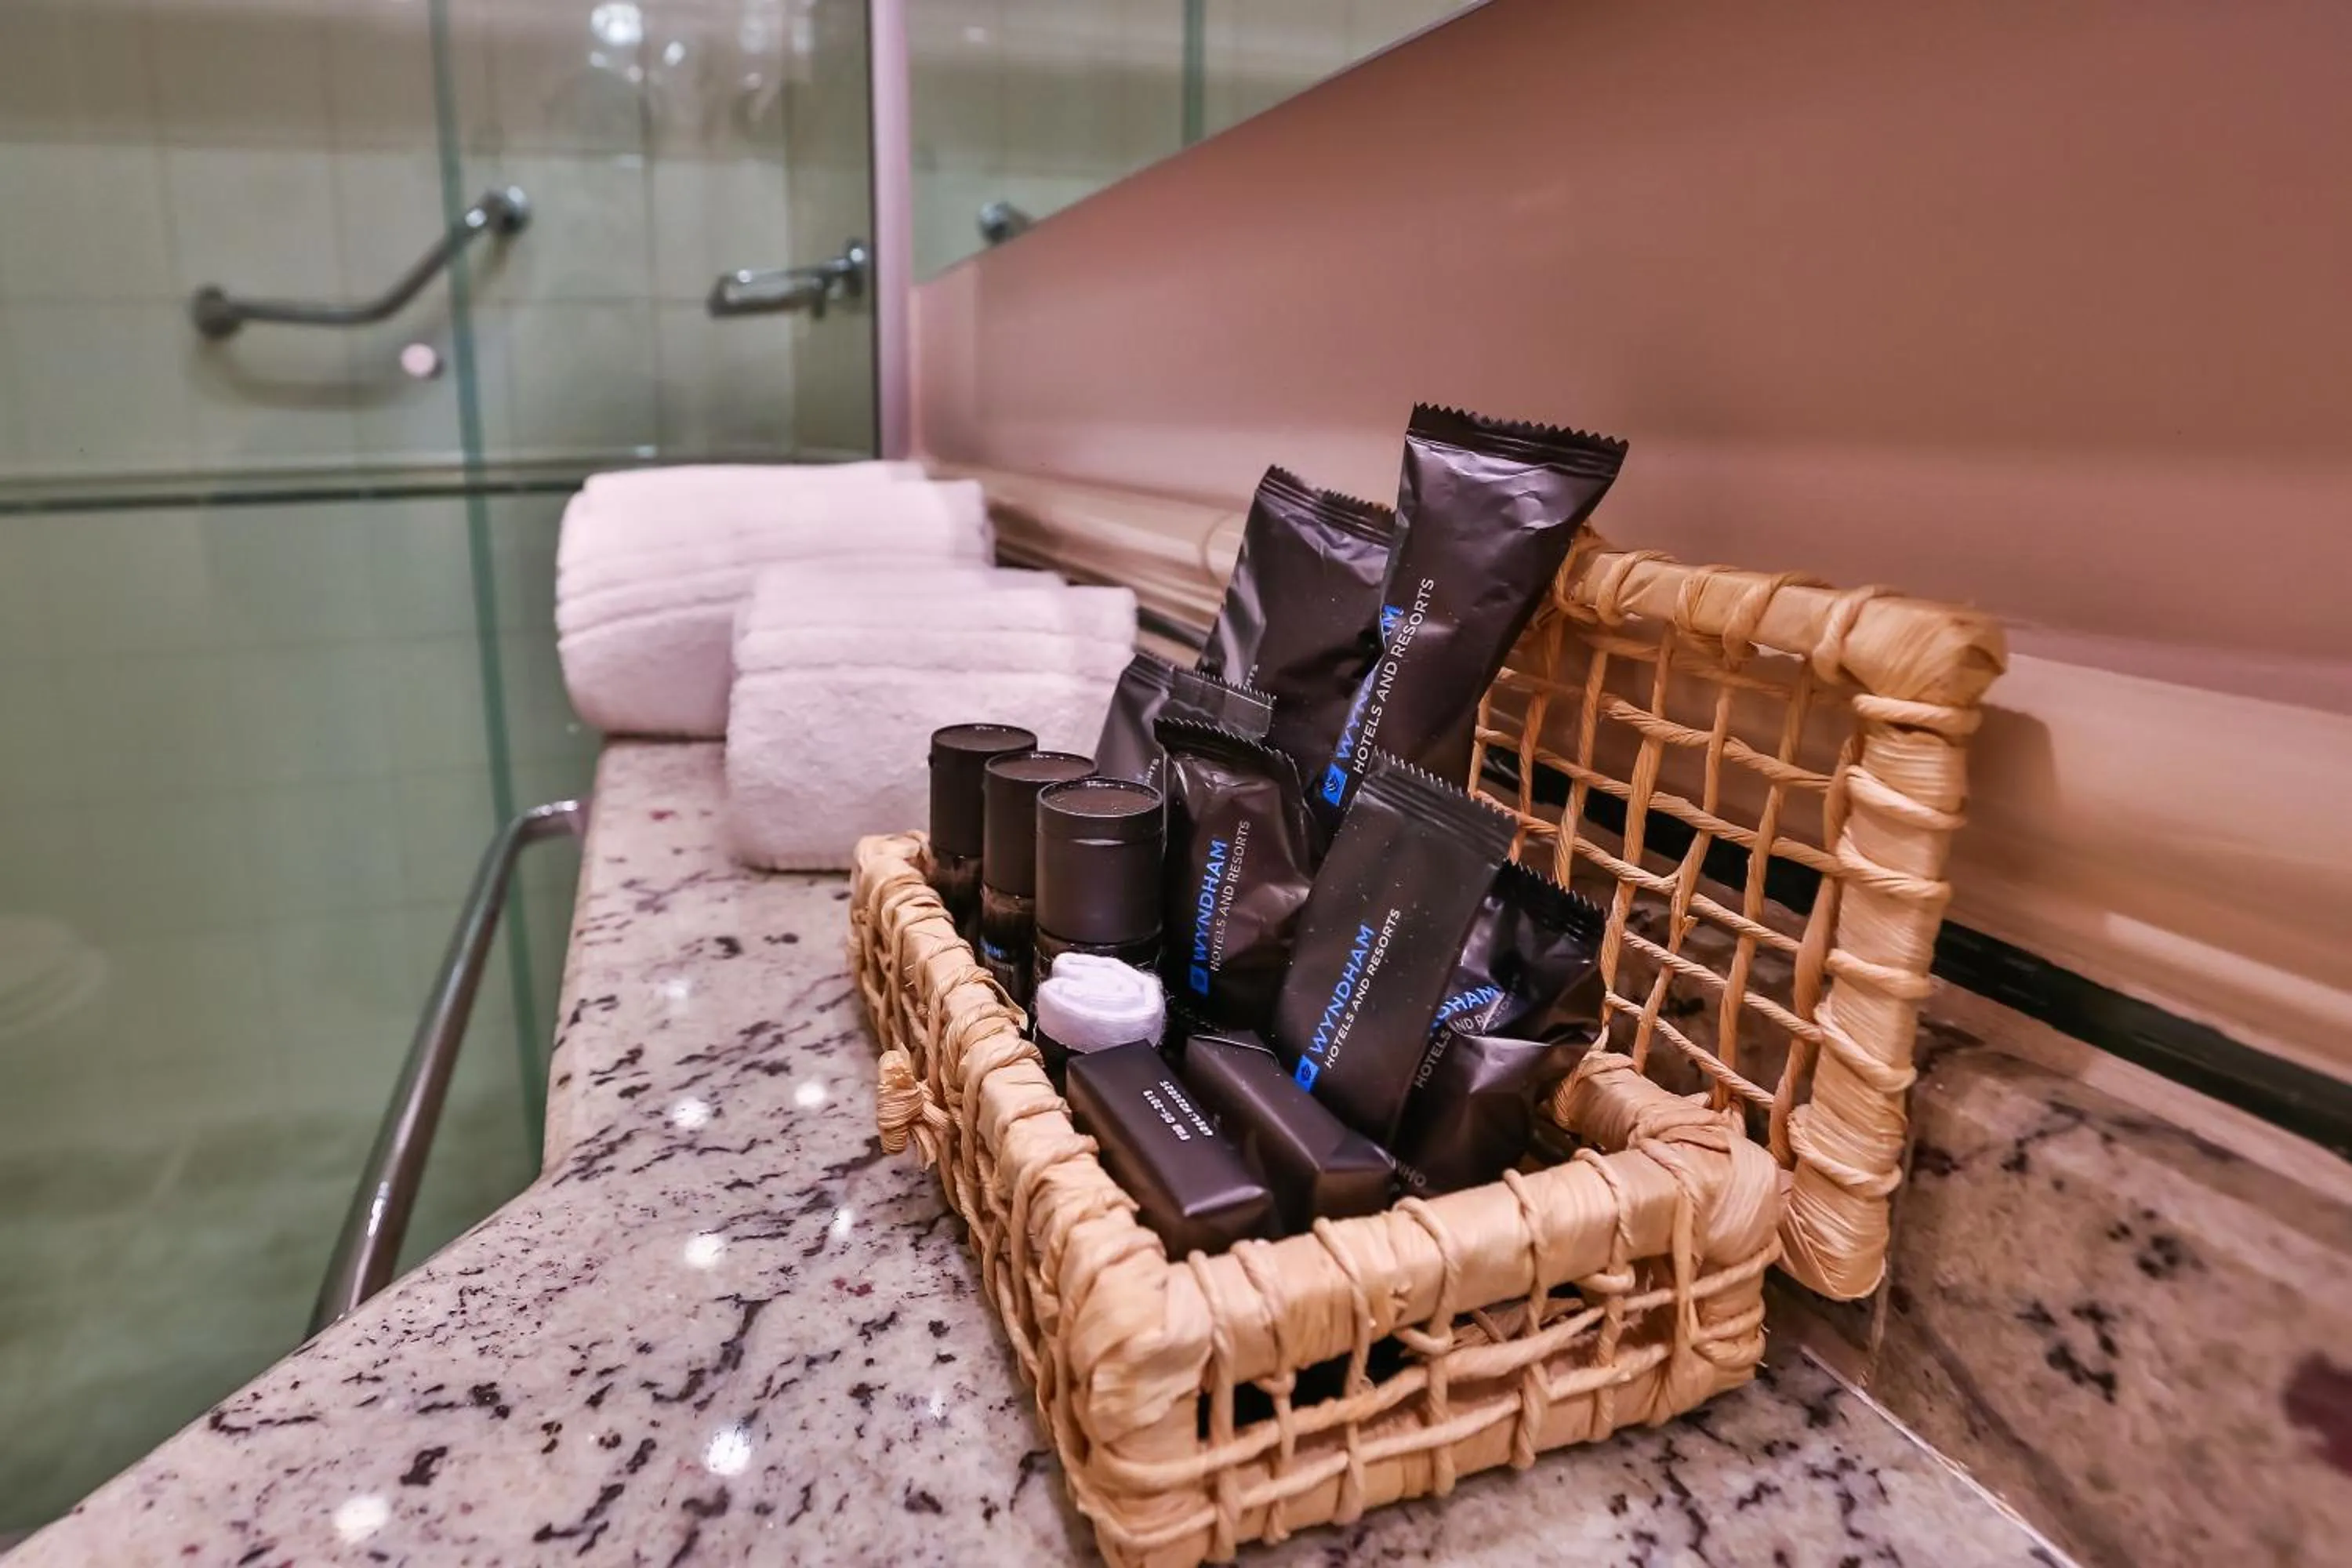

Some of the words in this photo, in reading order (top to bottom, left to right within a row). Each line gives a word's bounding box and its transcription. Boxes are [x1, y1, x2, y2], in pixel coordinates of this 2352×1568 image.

[1353, 705, 1382, 774] HOTELS
[1376, 660, 1398, 702] AND
[1391, 578, 1434, 659] RESORTS
[1193, 839, 1229, 961] WYNDHAM
[1210, 920, 1226, 971] HOTELS
[1218, 885, 1234, 916] AND
[1226, 820, 1250, 883] RESORTS
[1309, 924, 1374, 1054] WYNDHAM
[1324, 1012, 1355, 1069] HOTELS
[1352, 978, 1370, 1012] AND
[1367, 908, 1400, 975] RESORTS
[1414, 1030, 1451, 1088] HOTELS
[1454, 1018, 1473, 1032] ND
